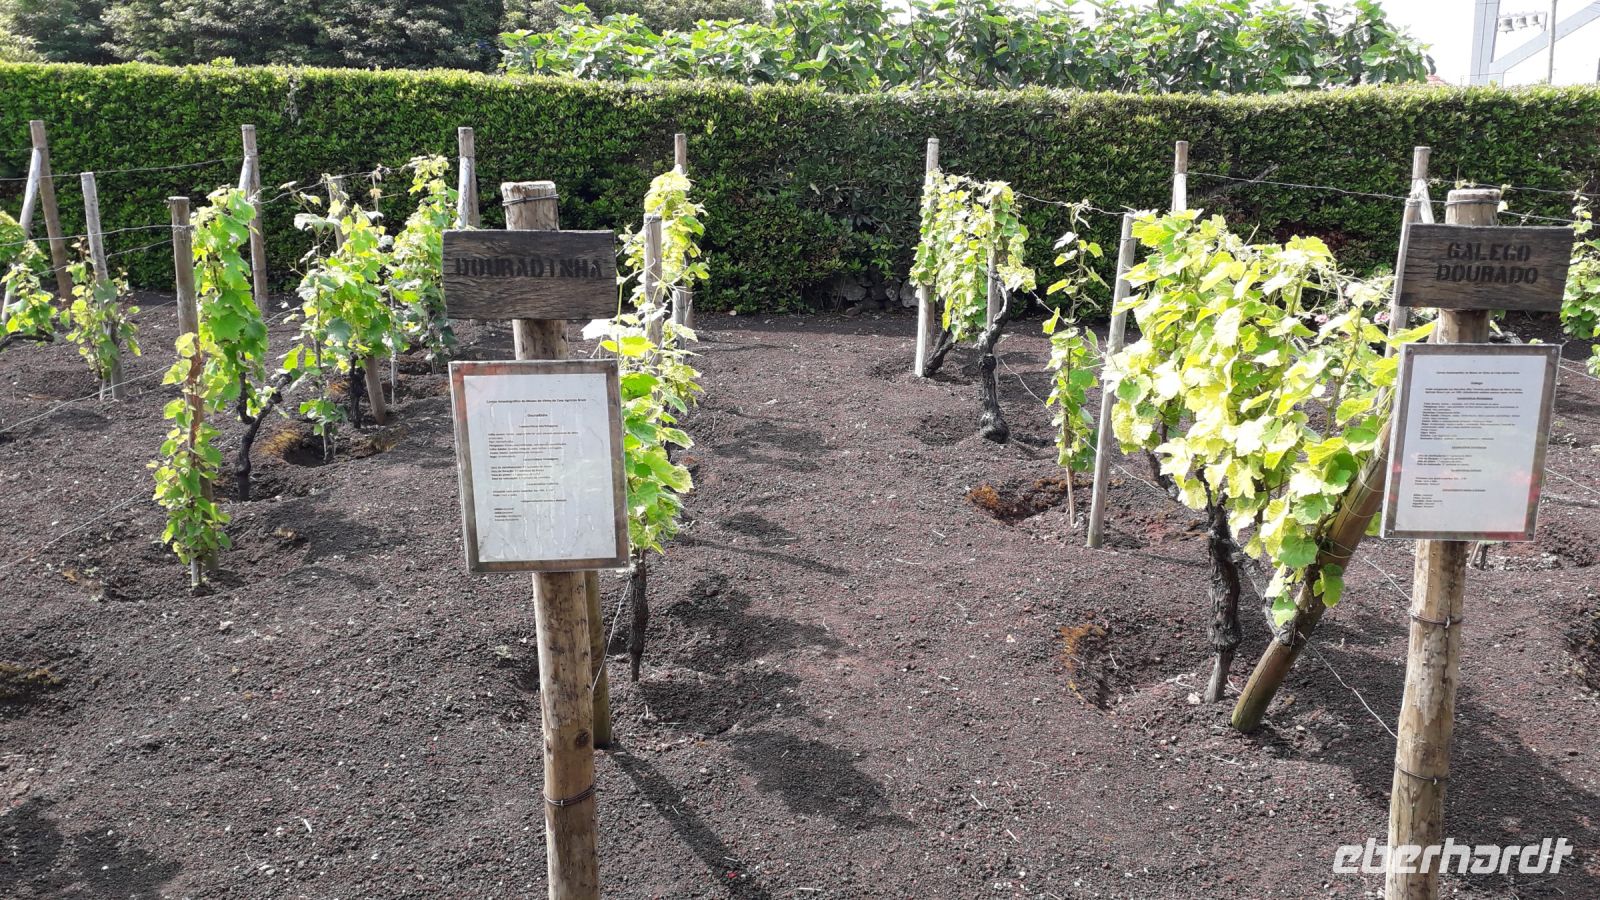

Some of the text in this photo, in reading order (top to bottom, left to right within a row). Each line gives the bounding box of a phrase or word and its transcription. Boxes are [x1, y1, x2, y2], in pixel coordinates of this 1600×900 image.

[1447, 241, 1532, 262] GALEGO
[455, 256, 603, 278] DOURADINHA
[1435, 263, 1539, 285] DOURADO
